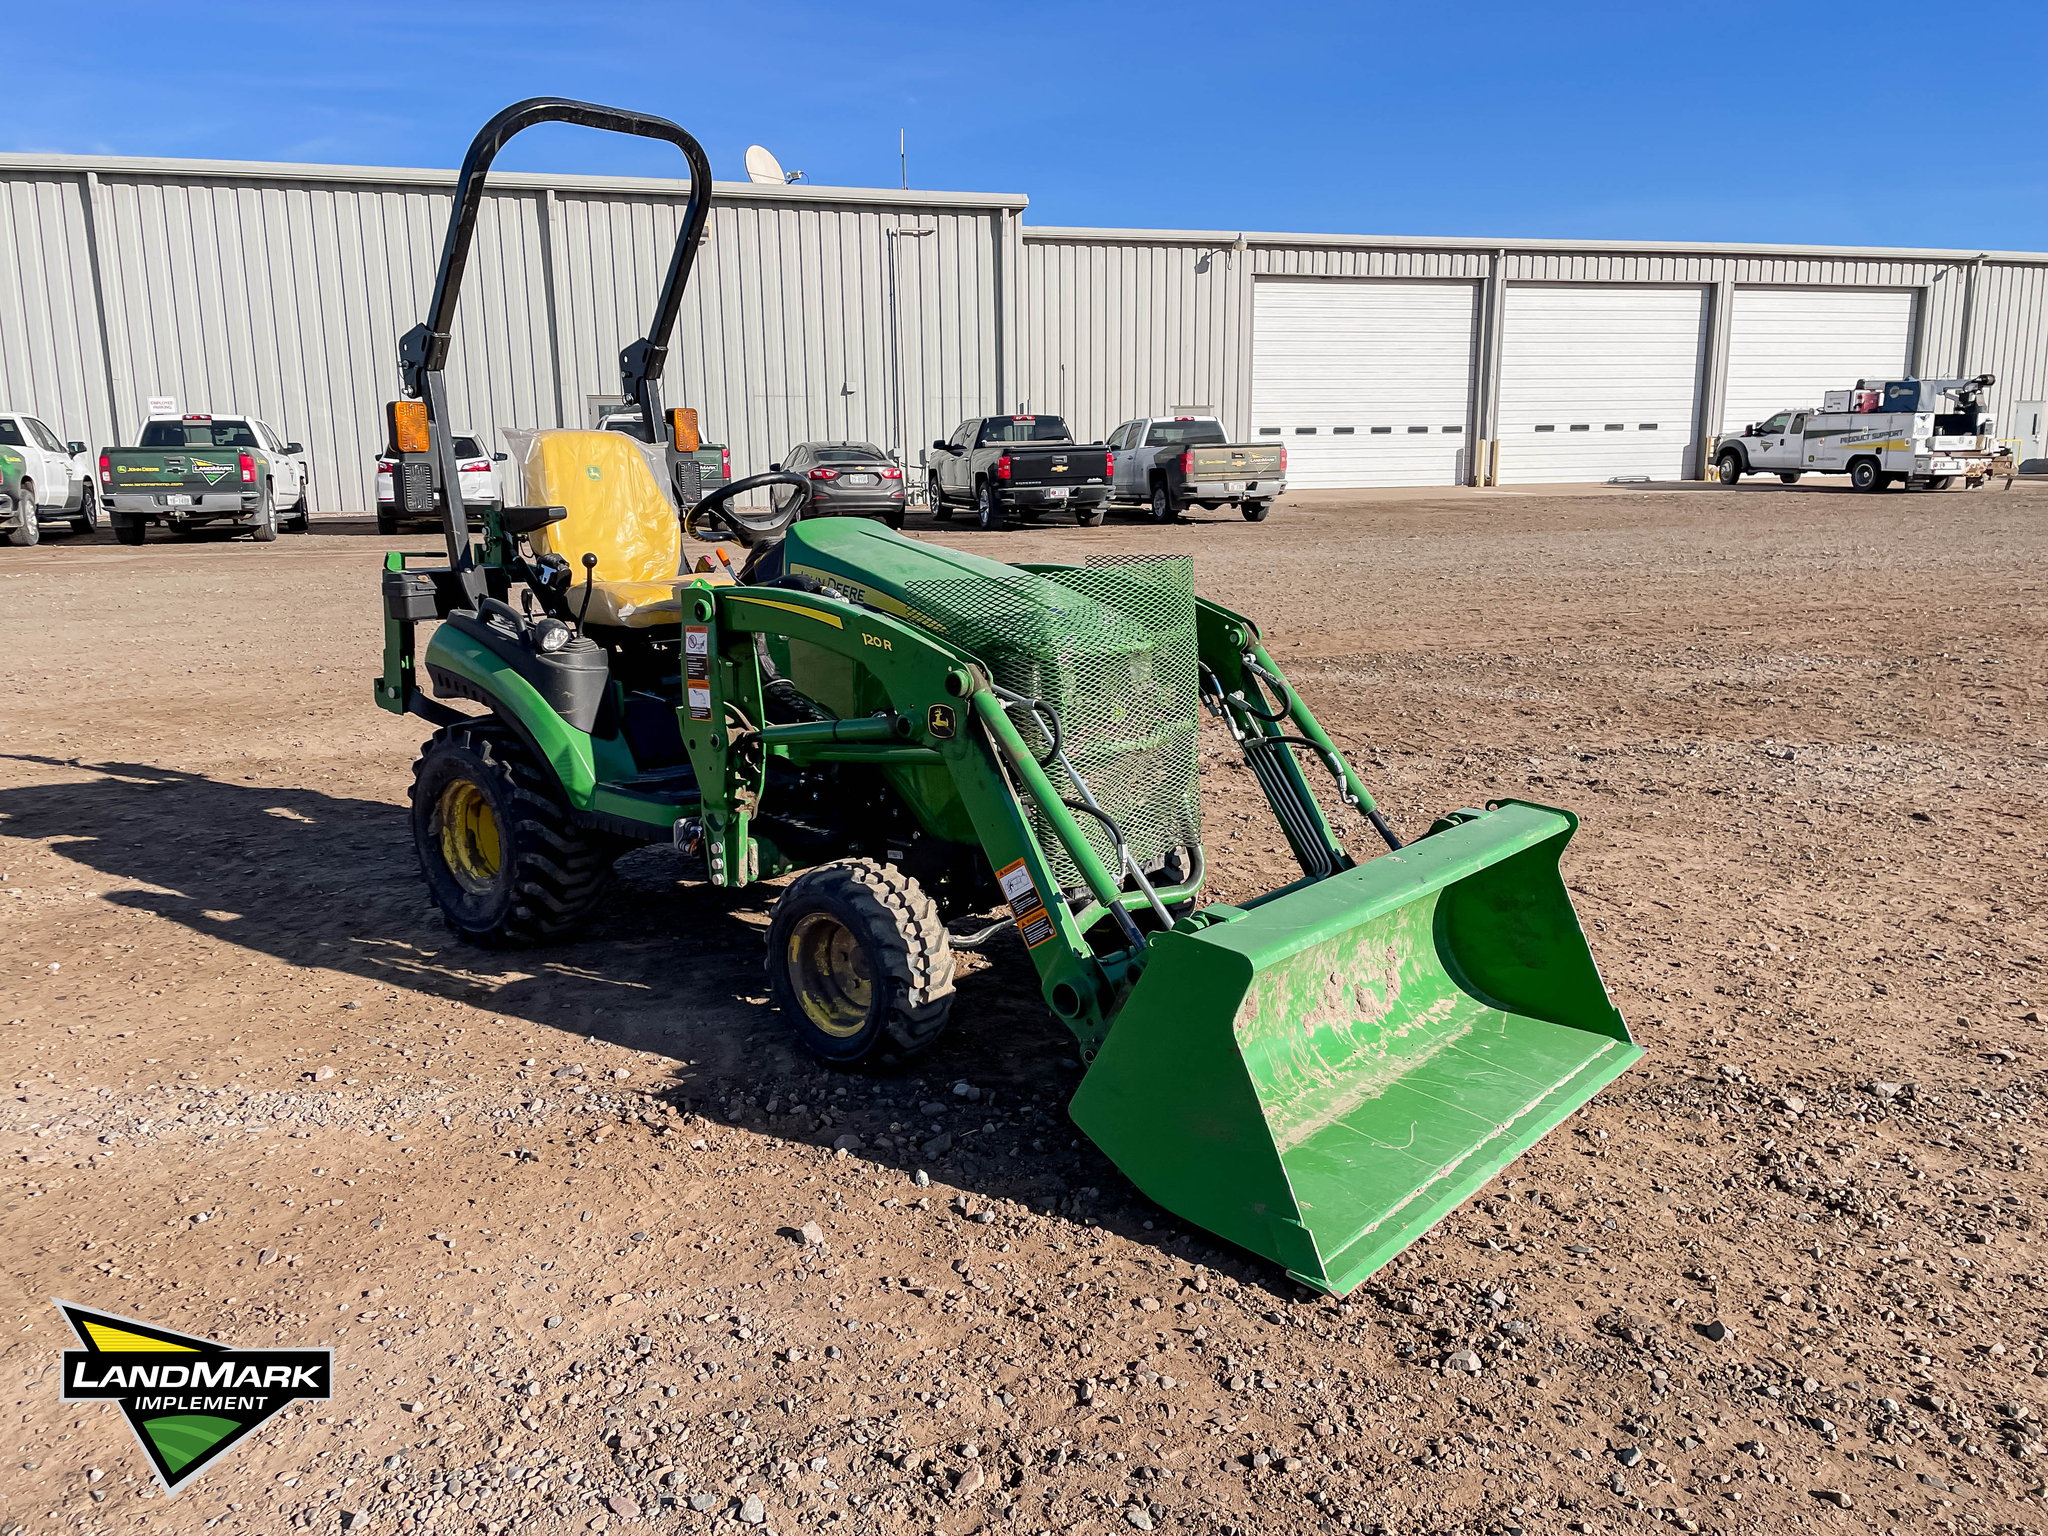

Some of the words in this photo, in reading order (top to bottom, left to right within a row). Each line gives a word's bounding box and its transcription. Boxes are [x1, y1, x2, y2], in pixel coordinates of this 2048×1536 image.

[1839, 433, 1870, 444] PRODUCT
[1871, 429, 1904, 440] SUPPORT
[828, 577, 865, 602] DEERE
